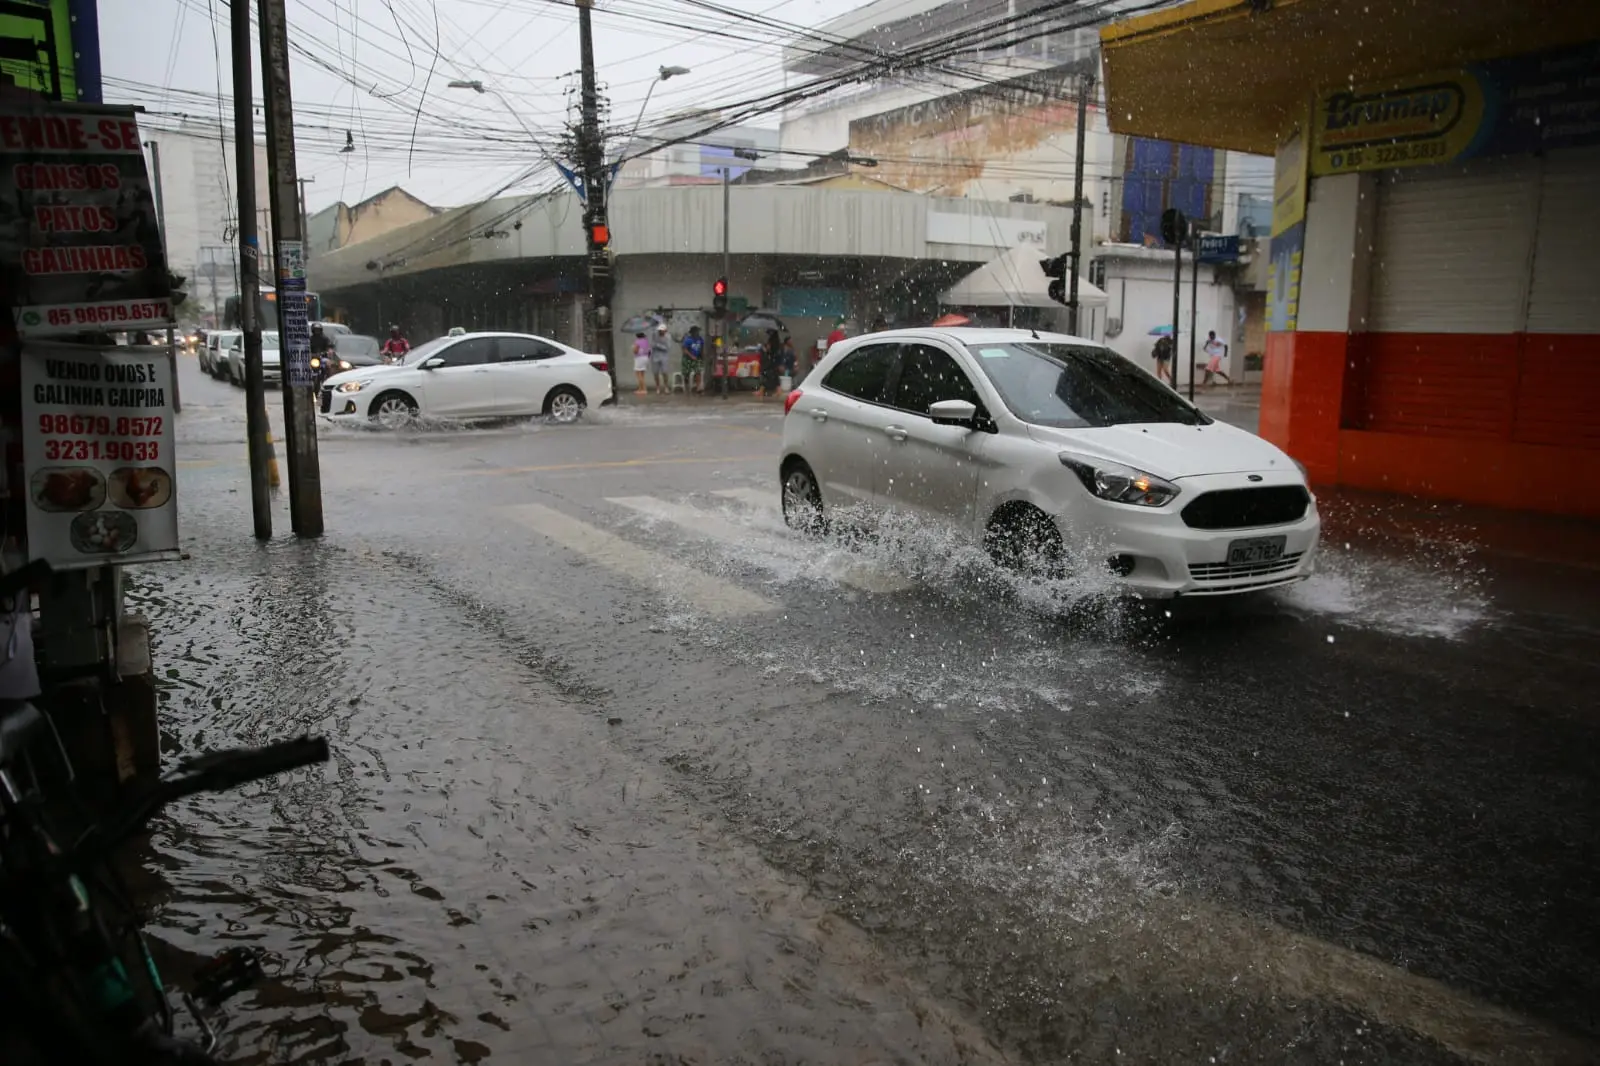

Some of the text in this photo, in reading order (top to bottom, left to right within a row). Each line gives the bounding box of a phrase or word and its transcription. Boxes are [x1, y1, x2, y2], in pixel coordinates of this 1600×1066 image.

[1323, 91, 1450, 130] Brumap
[35, 205, 118, 232] PATOS
[22, 245, 147, 275] GALINHAS
[48, 303, 169, 326] 85 98679.8572
[46, 359, 156, 383] VENDO OVOS E
[34, 384, 165, 408] GALINHA CAIPIRA
[39, 414, 163, 436] 98679.8572
[45, 440, 159, 461] 3231.9033
